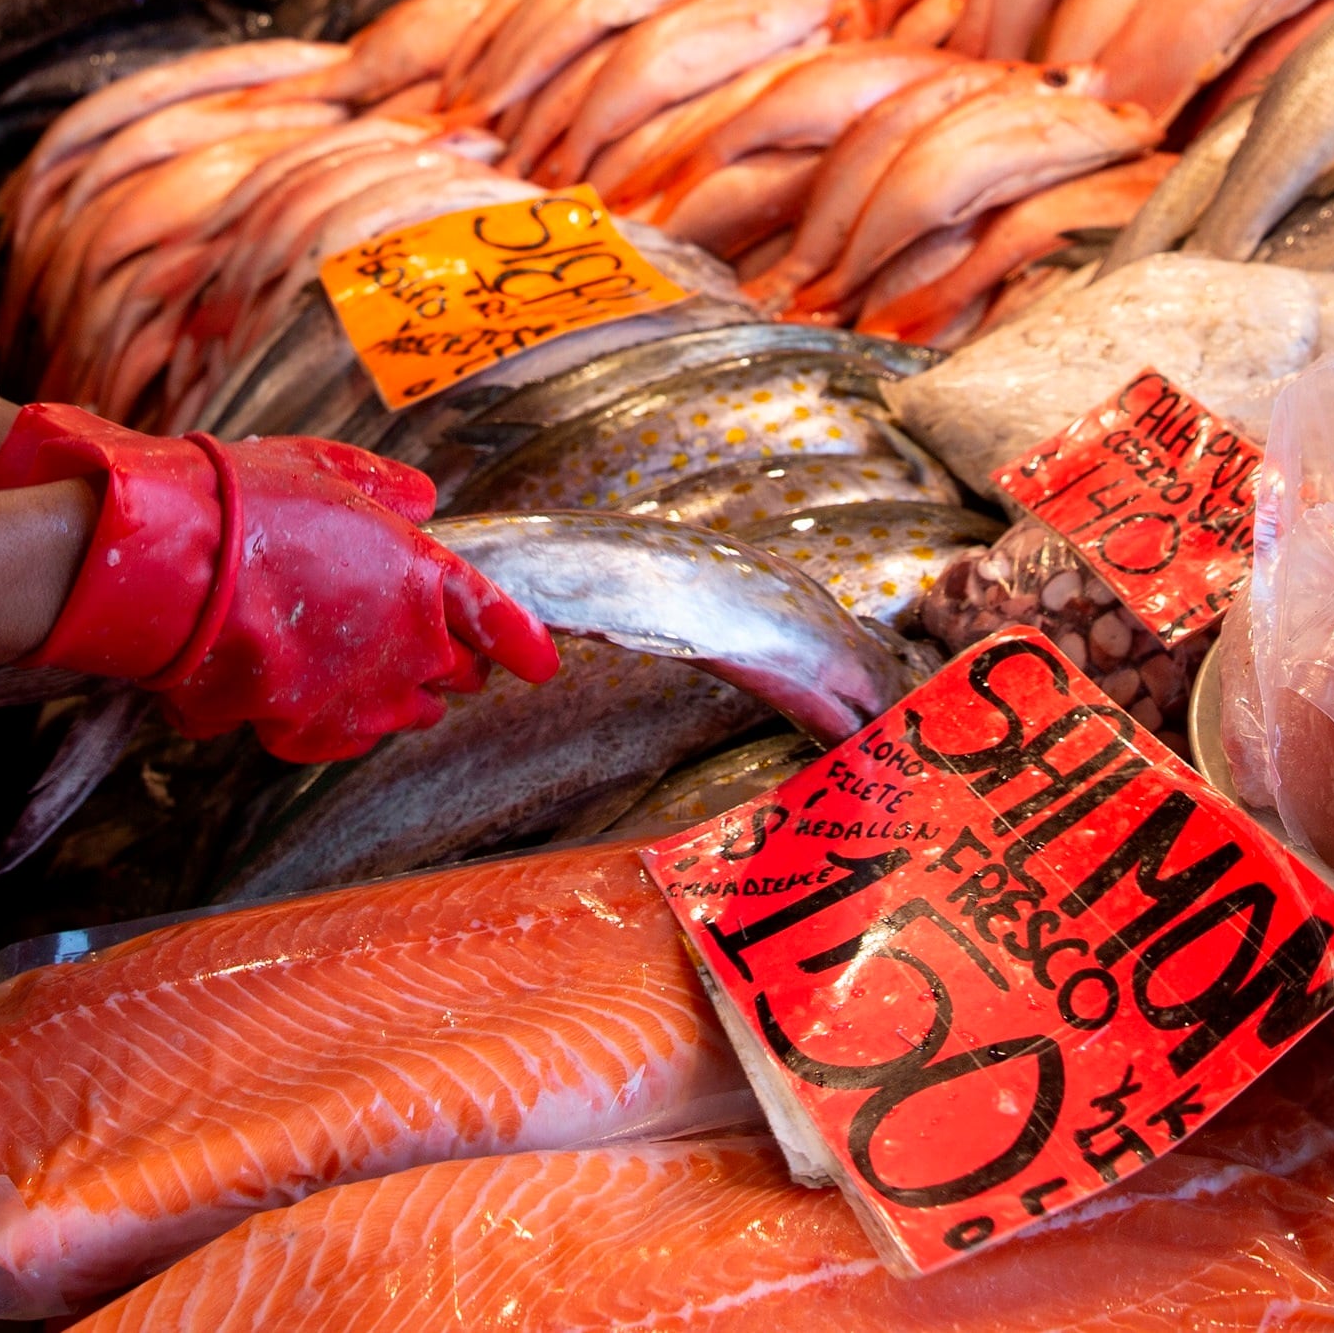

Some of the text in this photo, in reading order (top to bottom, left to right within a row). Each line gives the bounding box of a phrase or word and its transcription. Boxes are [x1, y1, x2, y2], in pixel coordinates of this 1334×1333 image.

[859, 728, 925, 777] LOMO
[827, 761, 914, 814] FILETE
[925, 826, 1120, 1031] FRESCO
